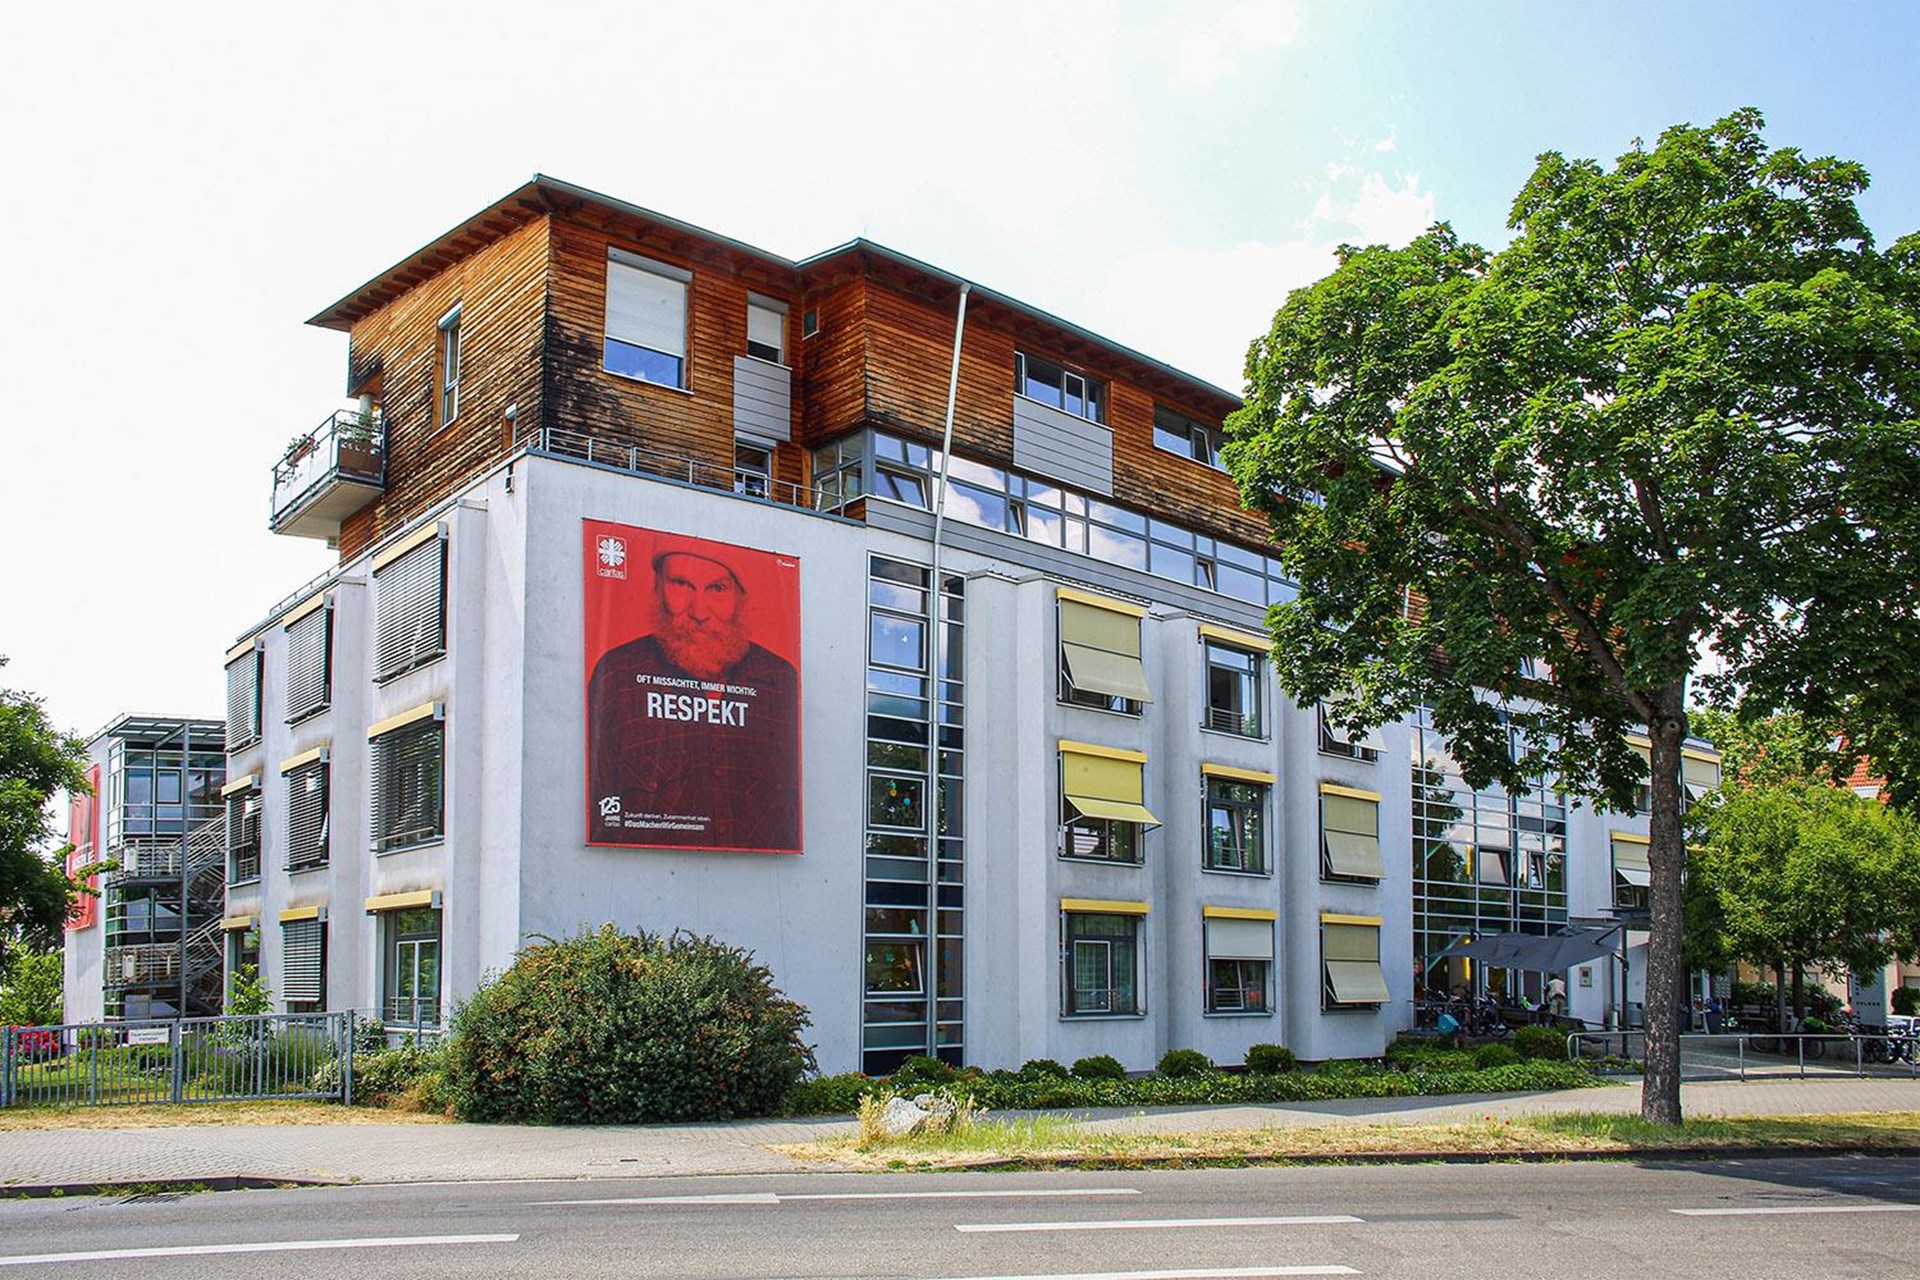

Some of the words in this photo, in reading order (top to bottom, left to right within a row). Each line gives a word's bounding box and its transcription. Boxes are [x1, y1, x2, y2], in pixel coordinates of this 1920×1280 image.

[636, 674, 652, 684] OFT
[653, 675, 701, 690] MISSACHTET,
[701, 681, 726, 692] IMMER
[726, 684, 757, 696] WICHTIG:
[647, 692, 749, 726] RESPEKT
[598, 796, 621, 816] 125
